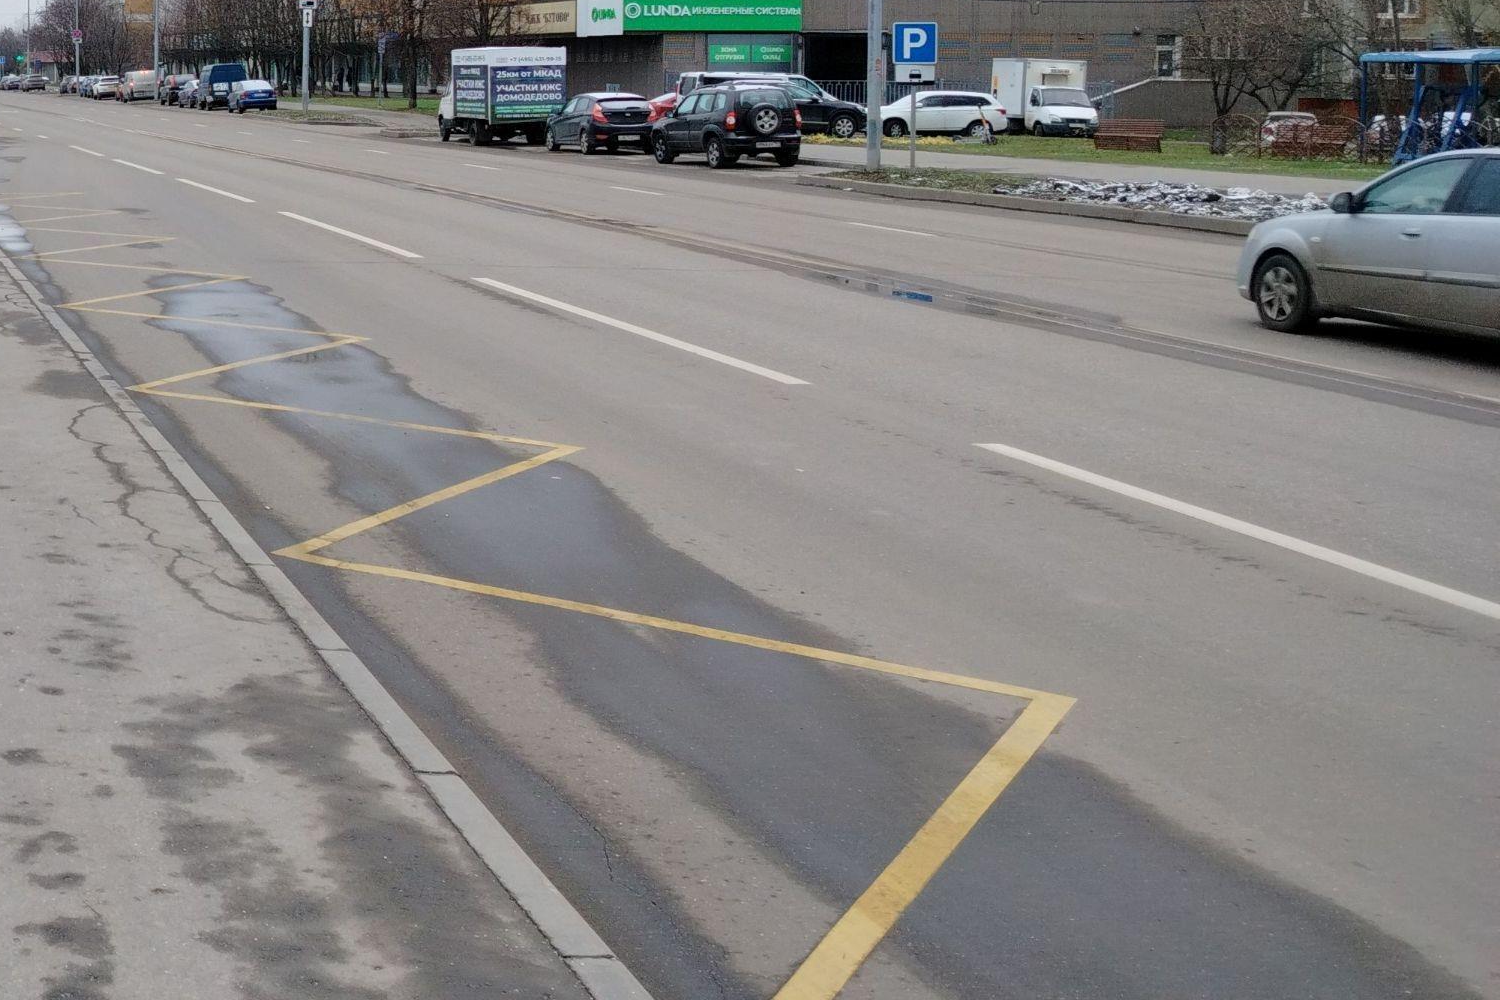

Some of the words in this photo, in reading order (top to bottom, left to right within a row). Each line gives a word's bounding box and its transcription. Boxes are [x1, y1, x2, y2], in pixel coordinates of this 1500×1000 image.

[643, 4, 692, 17] LUNDA
[692, 6, 755, 15] ИНЖЕНЕРНЫЕ
[755, 6, 801, 16] СИСТЕМЫ
[903, 27, 928, 59] P
[496, 70, 519, 78] 25км
[533, 69, 562, 78] МКАД
[496, 84, 538, 93] УЧАСТКИ
[540, 83, 562, 91] ИЖС
[496, 93, 562, 102] ДОМОДЕДОВО
